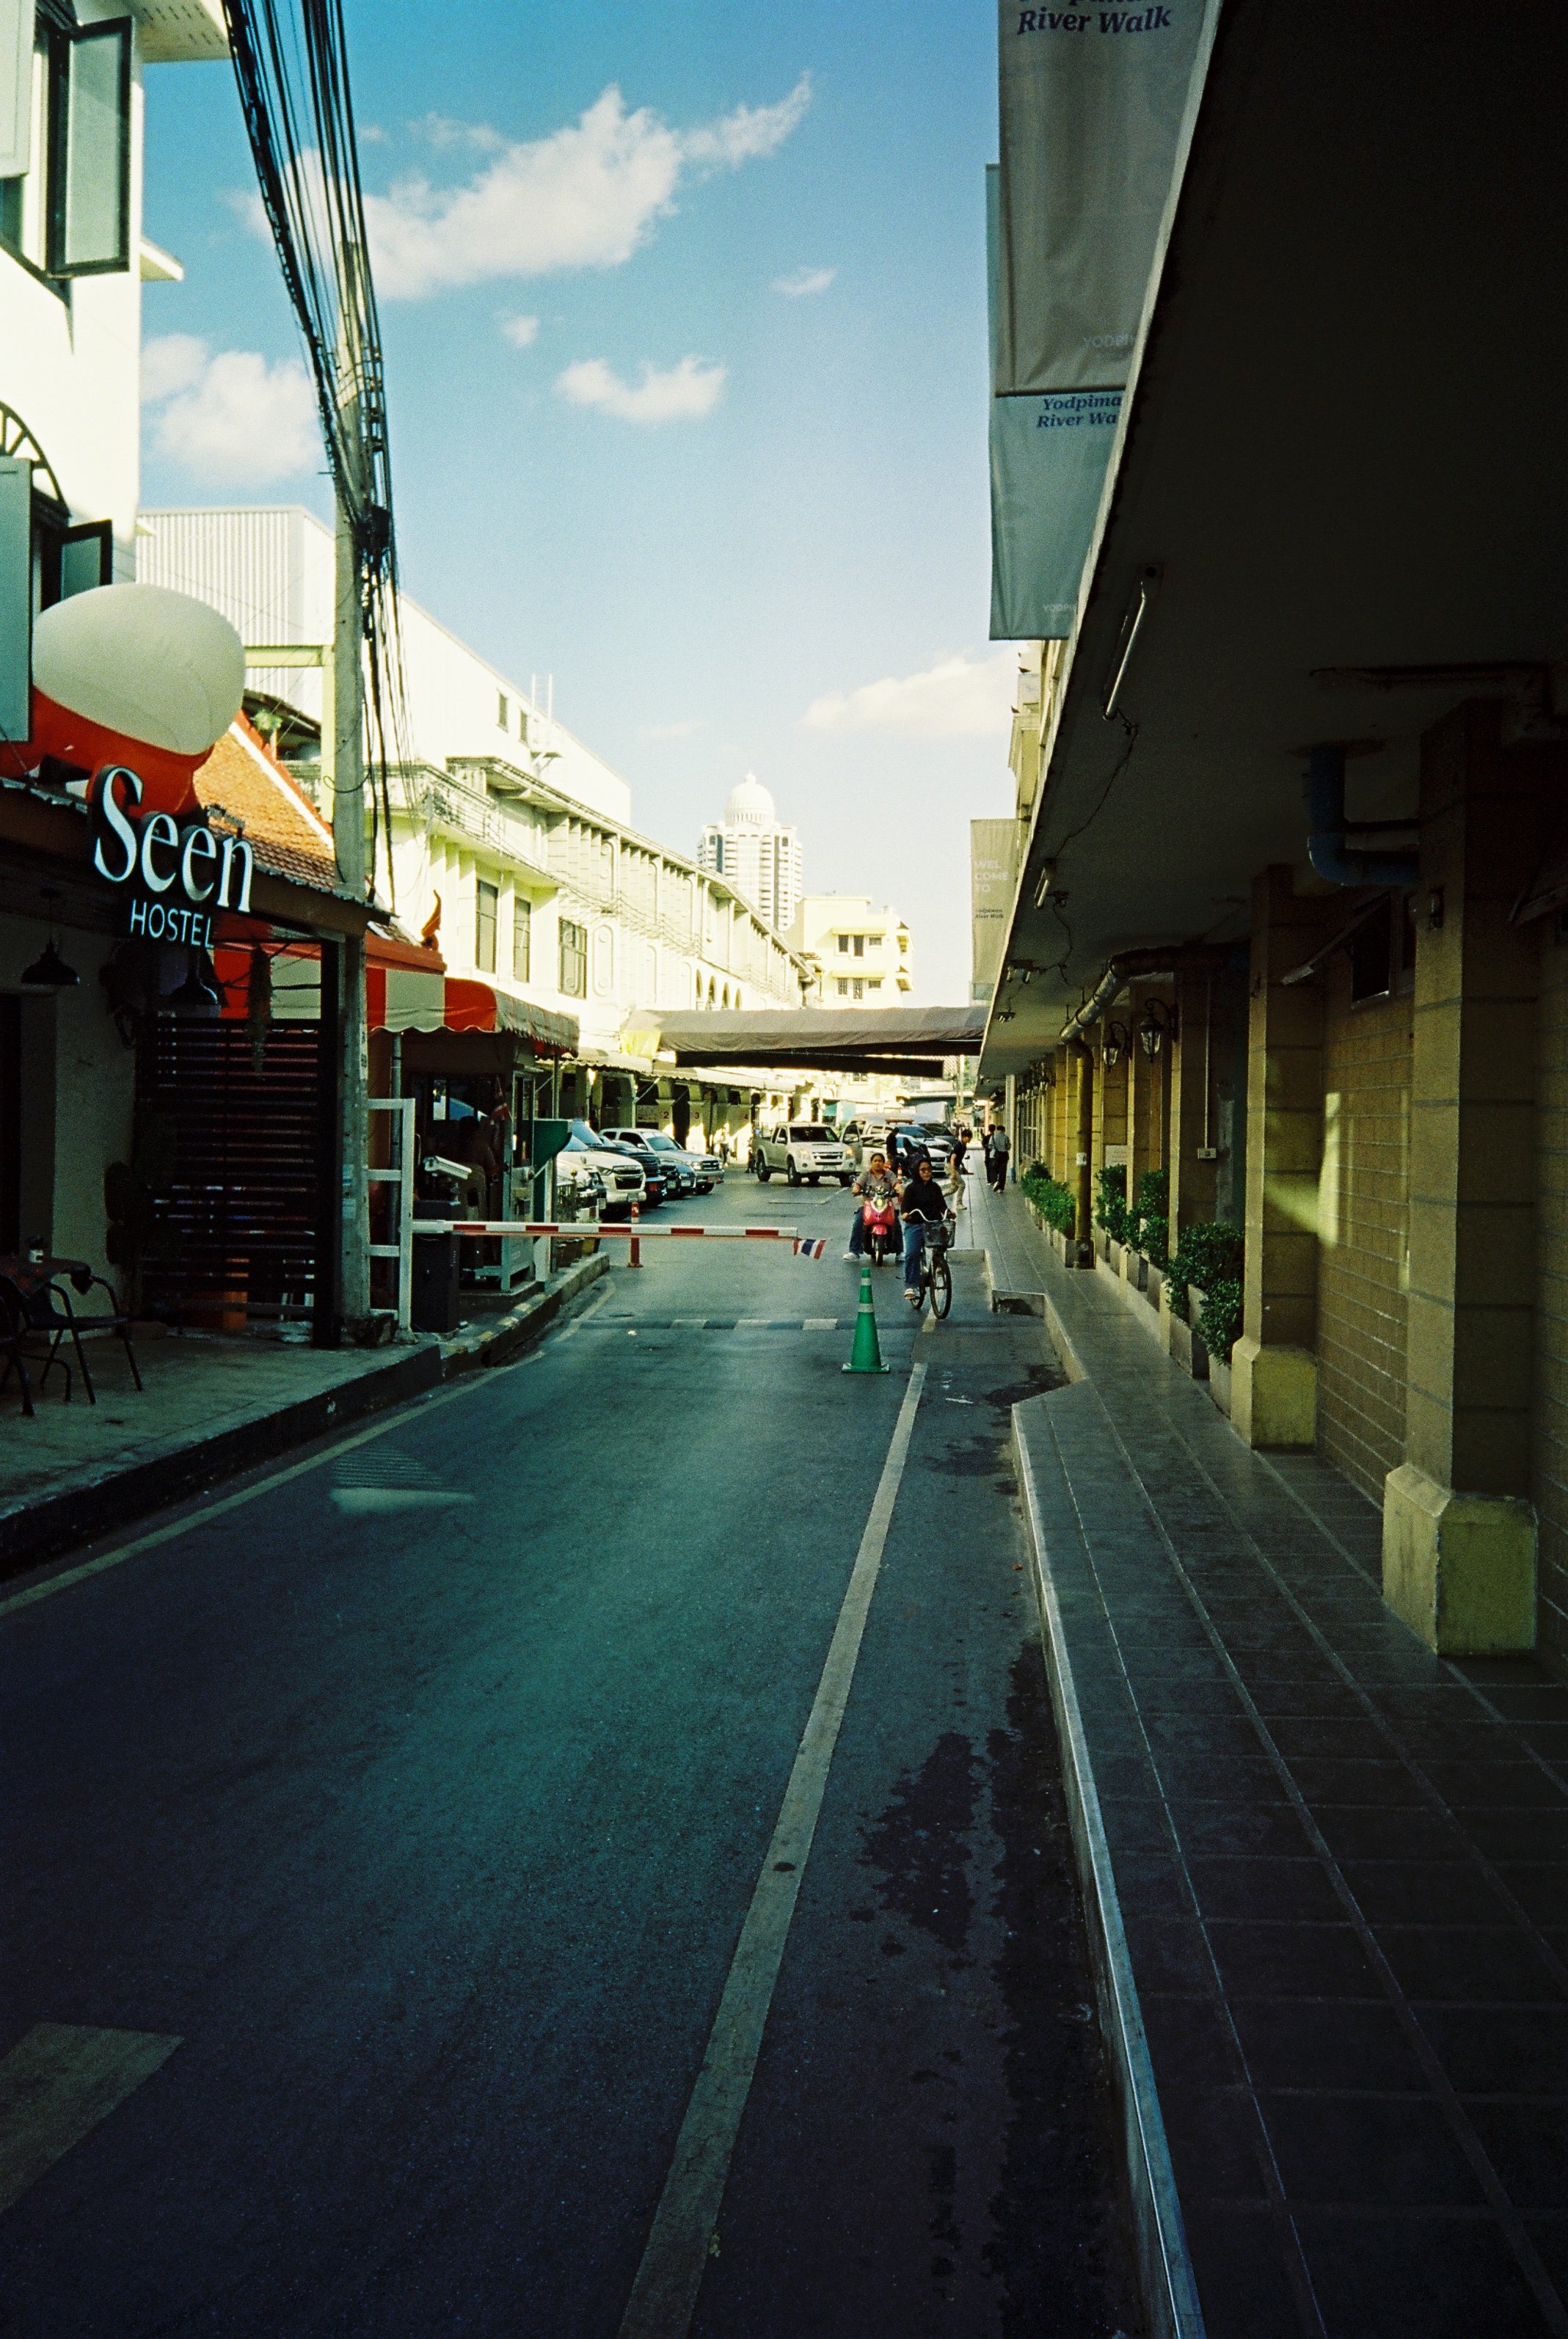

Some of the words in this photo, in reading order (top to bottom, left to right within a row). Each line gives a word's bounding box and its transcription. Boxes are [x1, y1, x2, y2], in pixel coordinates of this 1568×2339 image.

[1017, 7, 1092, 35] River
[1098, 6, 1172, 34] Walk
[1043, 395, 1123, 412] Yodpima
[1037, 414, 1084, 428] River
[1090, 412, 1117, 424] Wa
[93, 767, 254, 913] Seen
[130, 898, 215, 949] HOSTEL
[663, 1111, 669, 1120] 2
